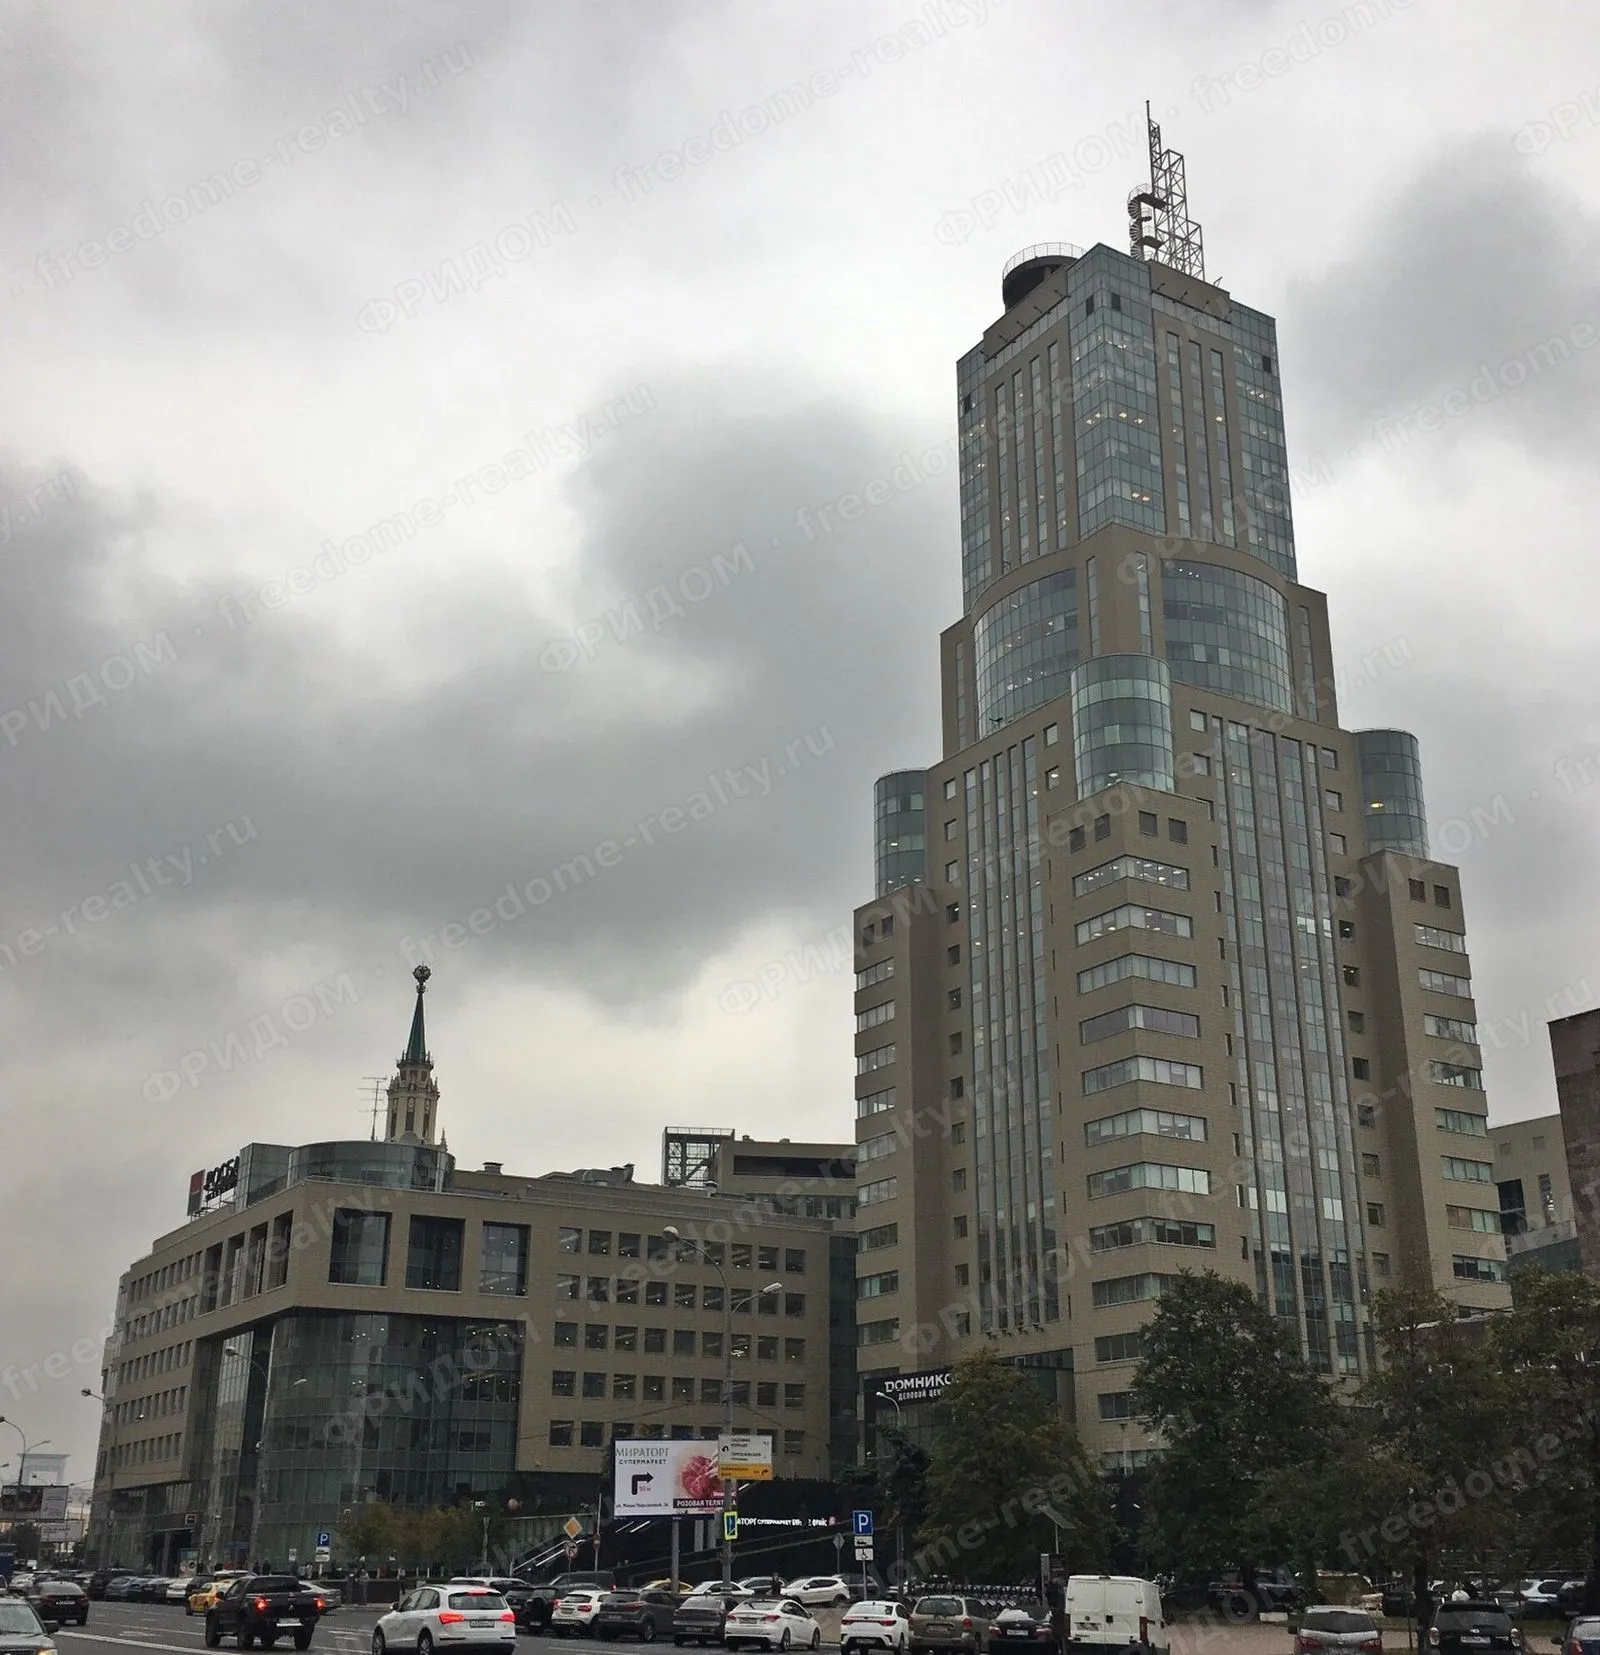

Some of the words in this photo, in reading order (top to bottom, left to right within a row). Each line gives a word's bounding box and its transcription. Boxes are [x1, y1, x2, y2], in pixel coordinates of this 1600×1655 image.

[929, 1388, 942, 1398] ЦЕН
[615, 1447, 670, 1457] МИРАТОРГ
[705, 1499, 737, 1507] ТЕЛЯТА
[737, 1518, 757, 1526] АТОРГ
